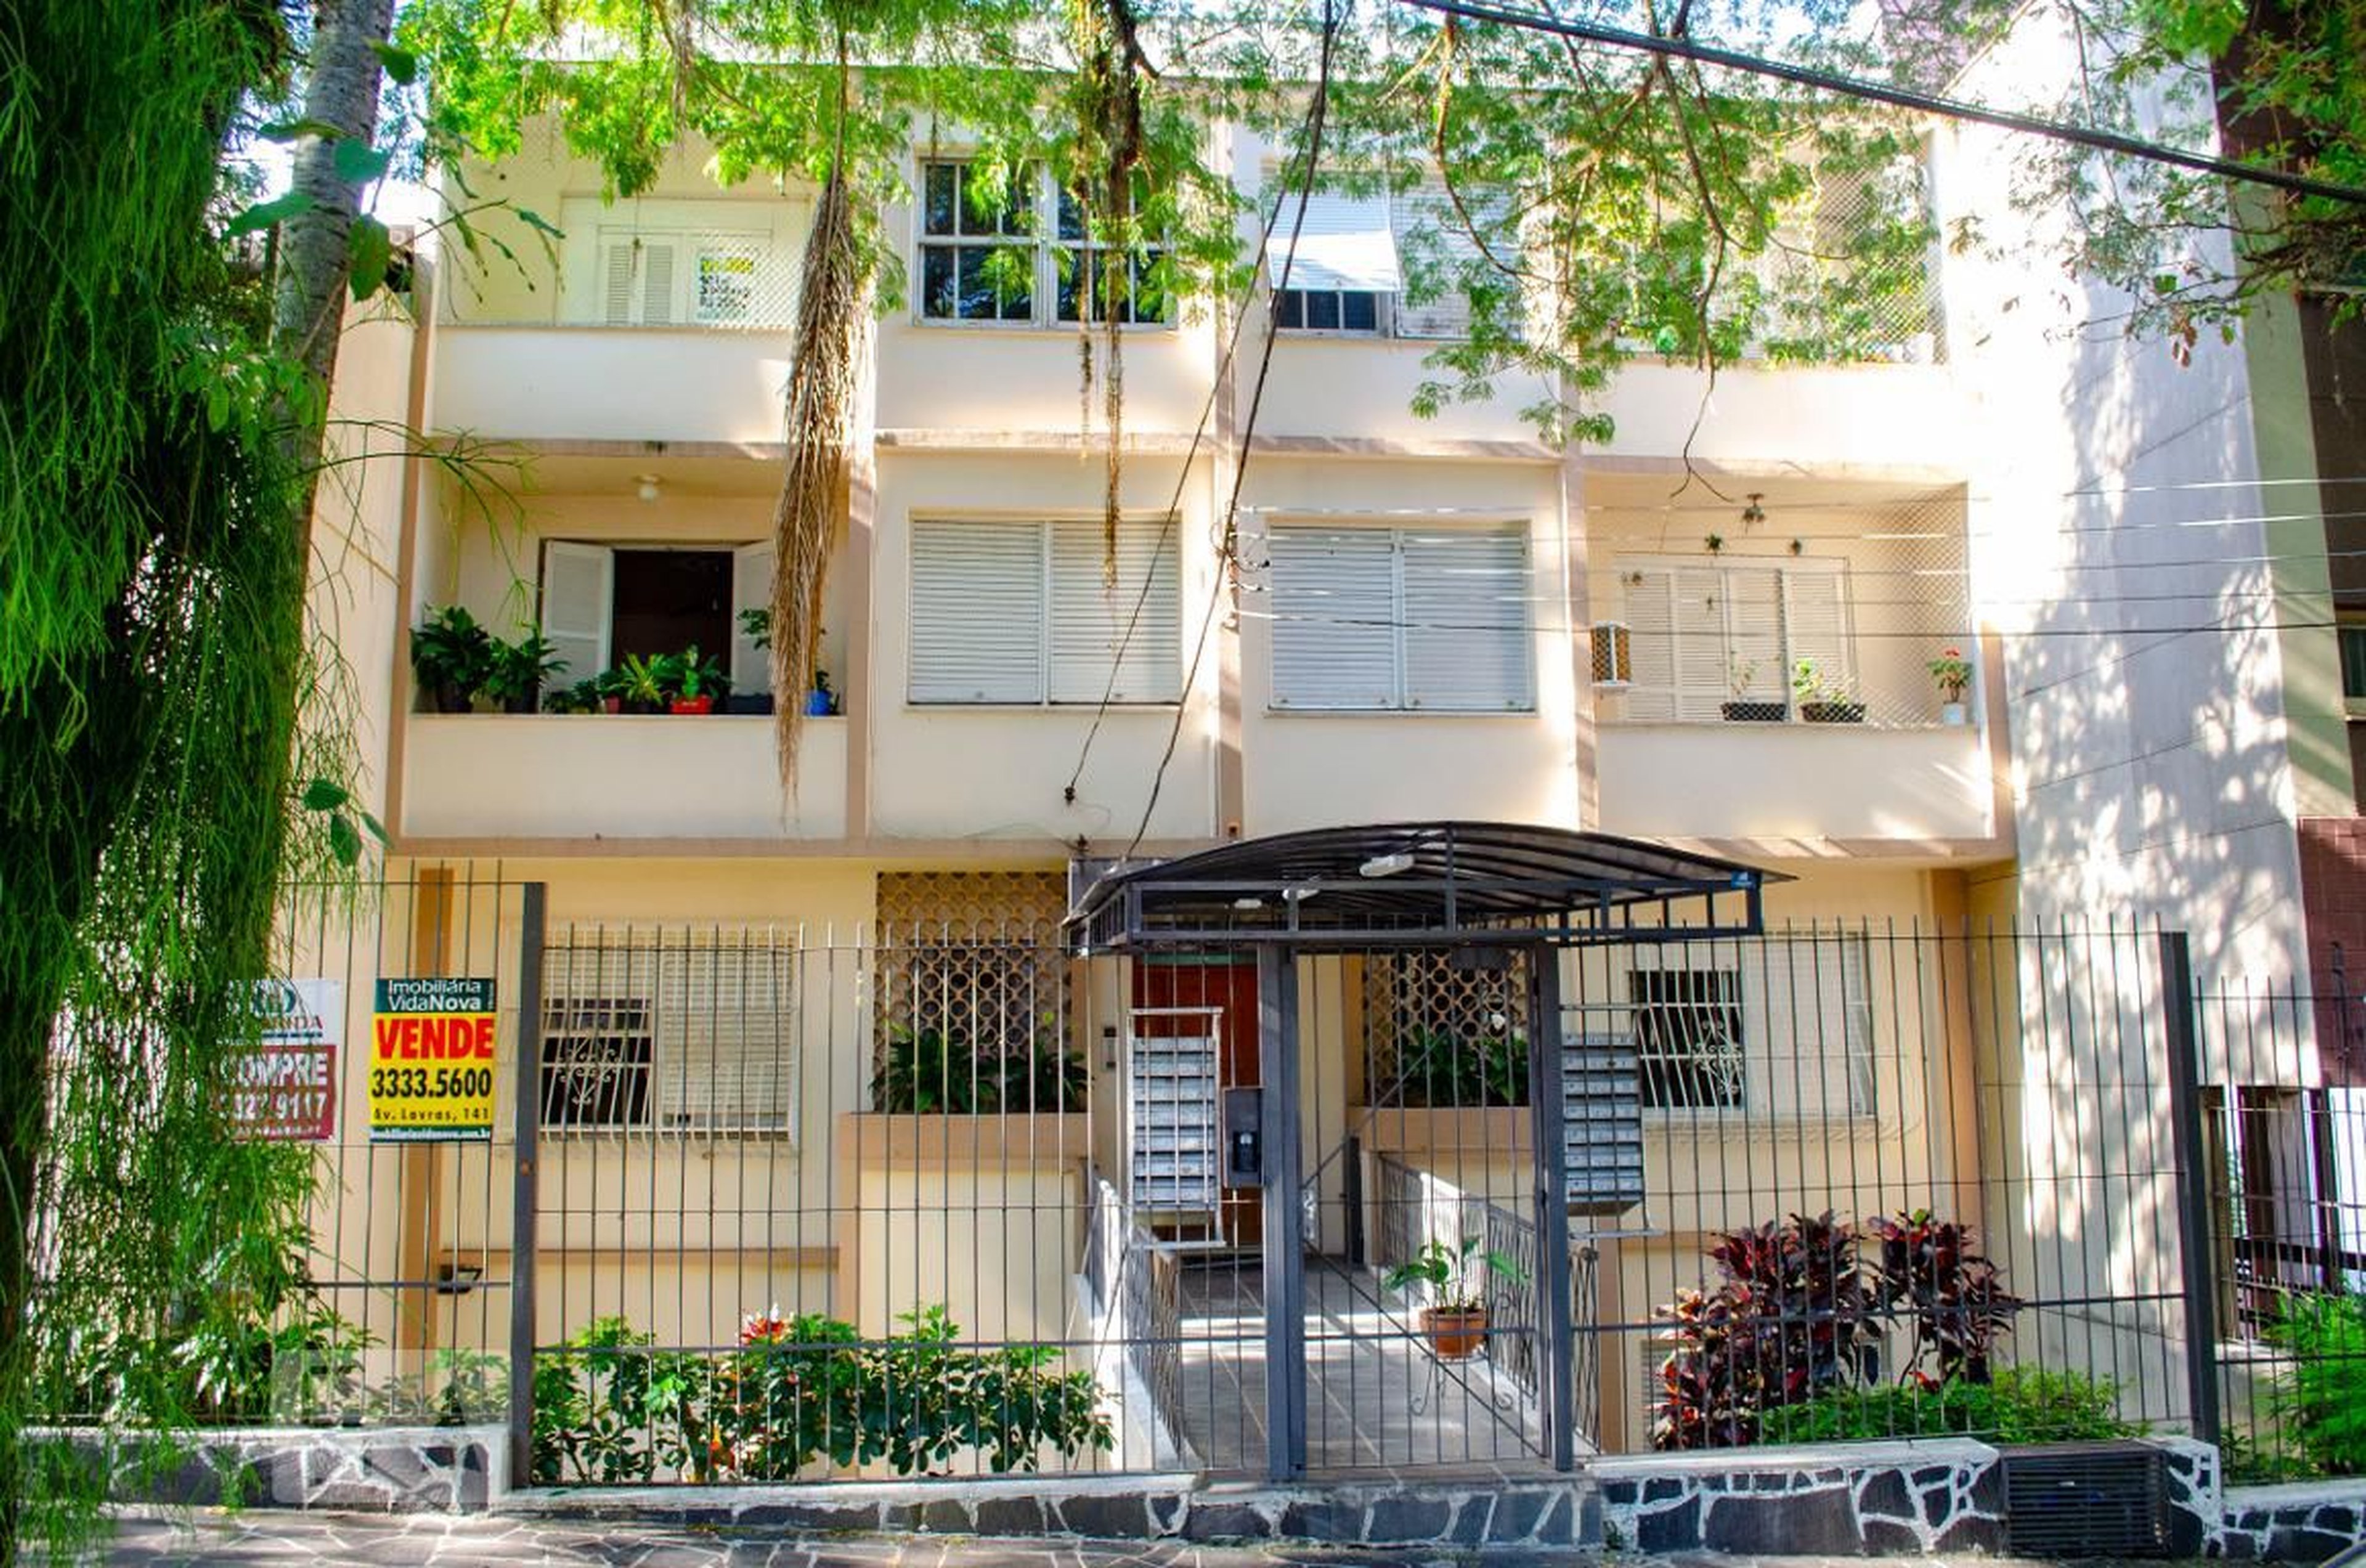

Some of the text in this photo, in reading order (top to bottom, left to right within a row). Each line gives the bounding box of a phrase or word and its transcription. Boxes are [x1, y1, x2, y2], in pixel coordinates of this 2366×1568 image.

[389, 979, 481, 994] Imobiliária
[388, 994, 481, 1011] VidaNova
[376, 1018, 494, 1059] VENDE
[372, 1068, 492, 1098] 3333.5600
[373, 1108, 489, 1123] Av. Lavras, 141
